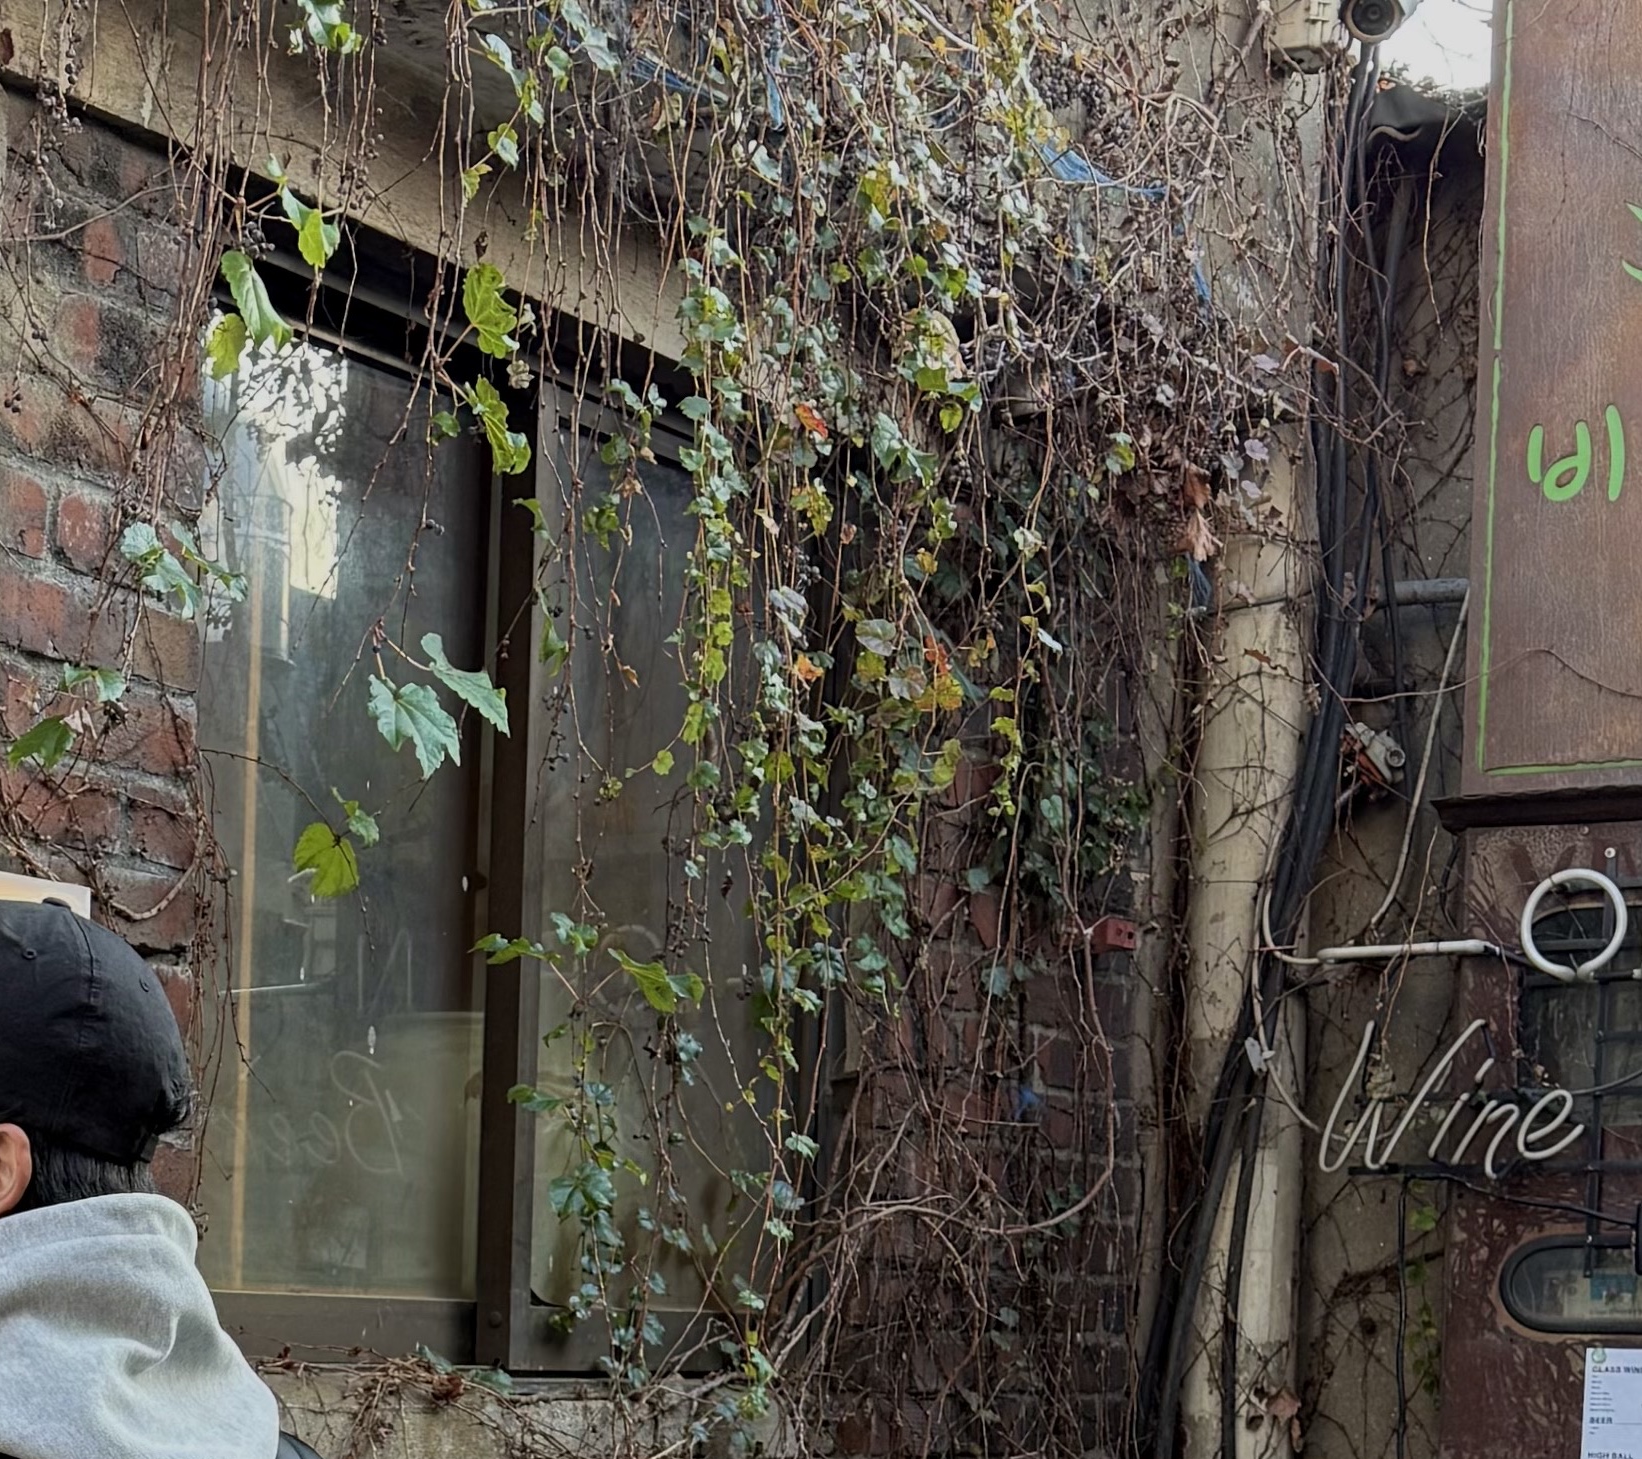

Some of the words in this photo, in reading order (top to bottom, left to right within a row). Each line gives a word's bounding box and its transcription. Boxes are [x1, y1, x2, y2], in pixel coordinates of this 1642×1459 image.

[1526, 403, 1625, 502] 비
[1319, 1018, 1585, 1180] Wine
[1624, 1366, 1642, 1375] WIN
[1587, 1452, 1609, 1459] HIGH
